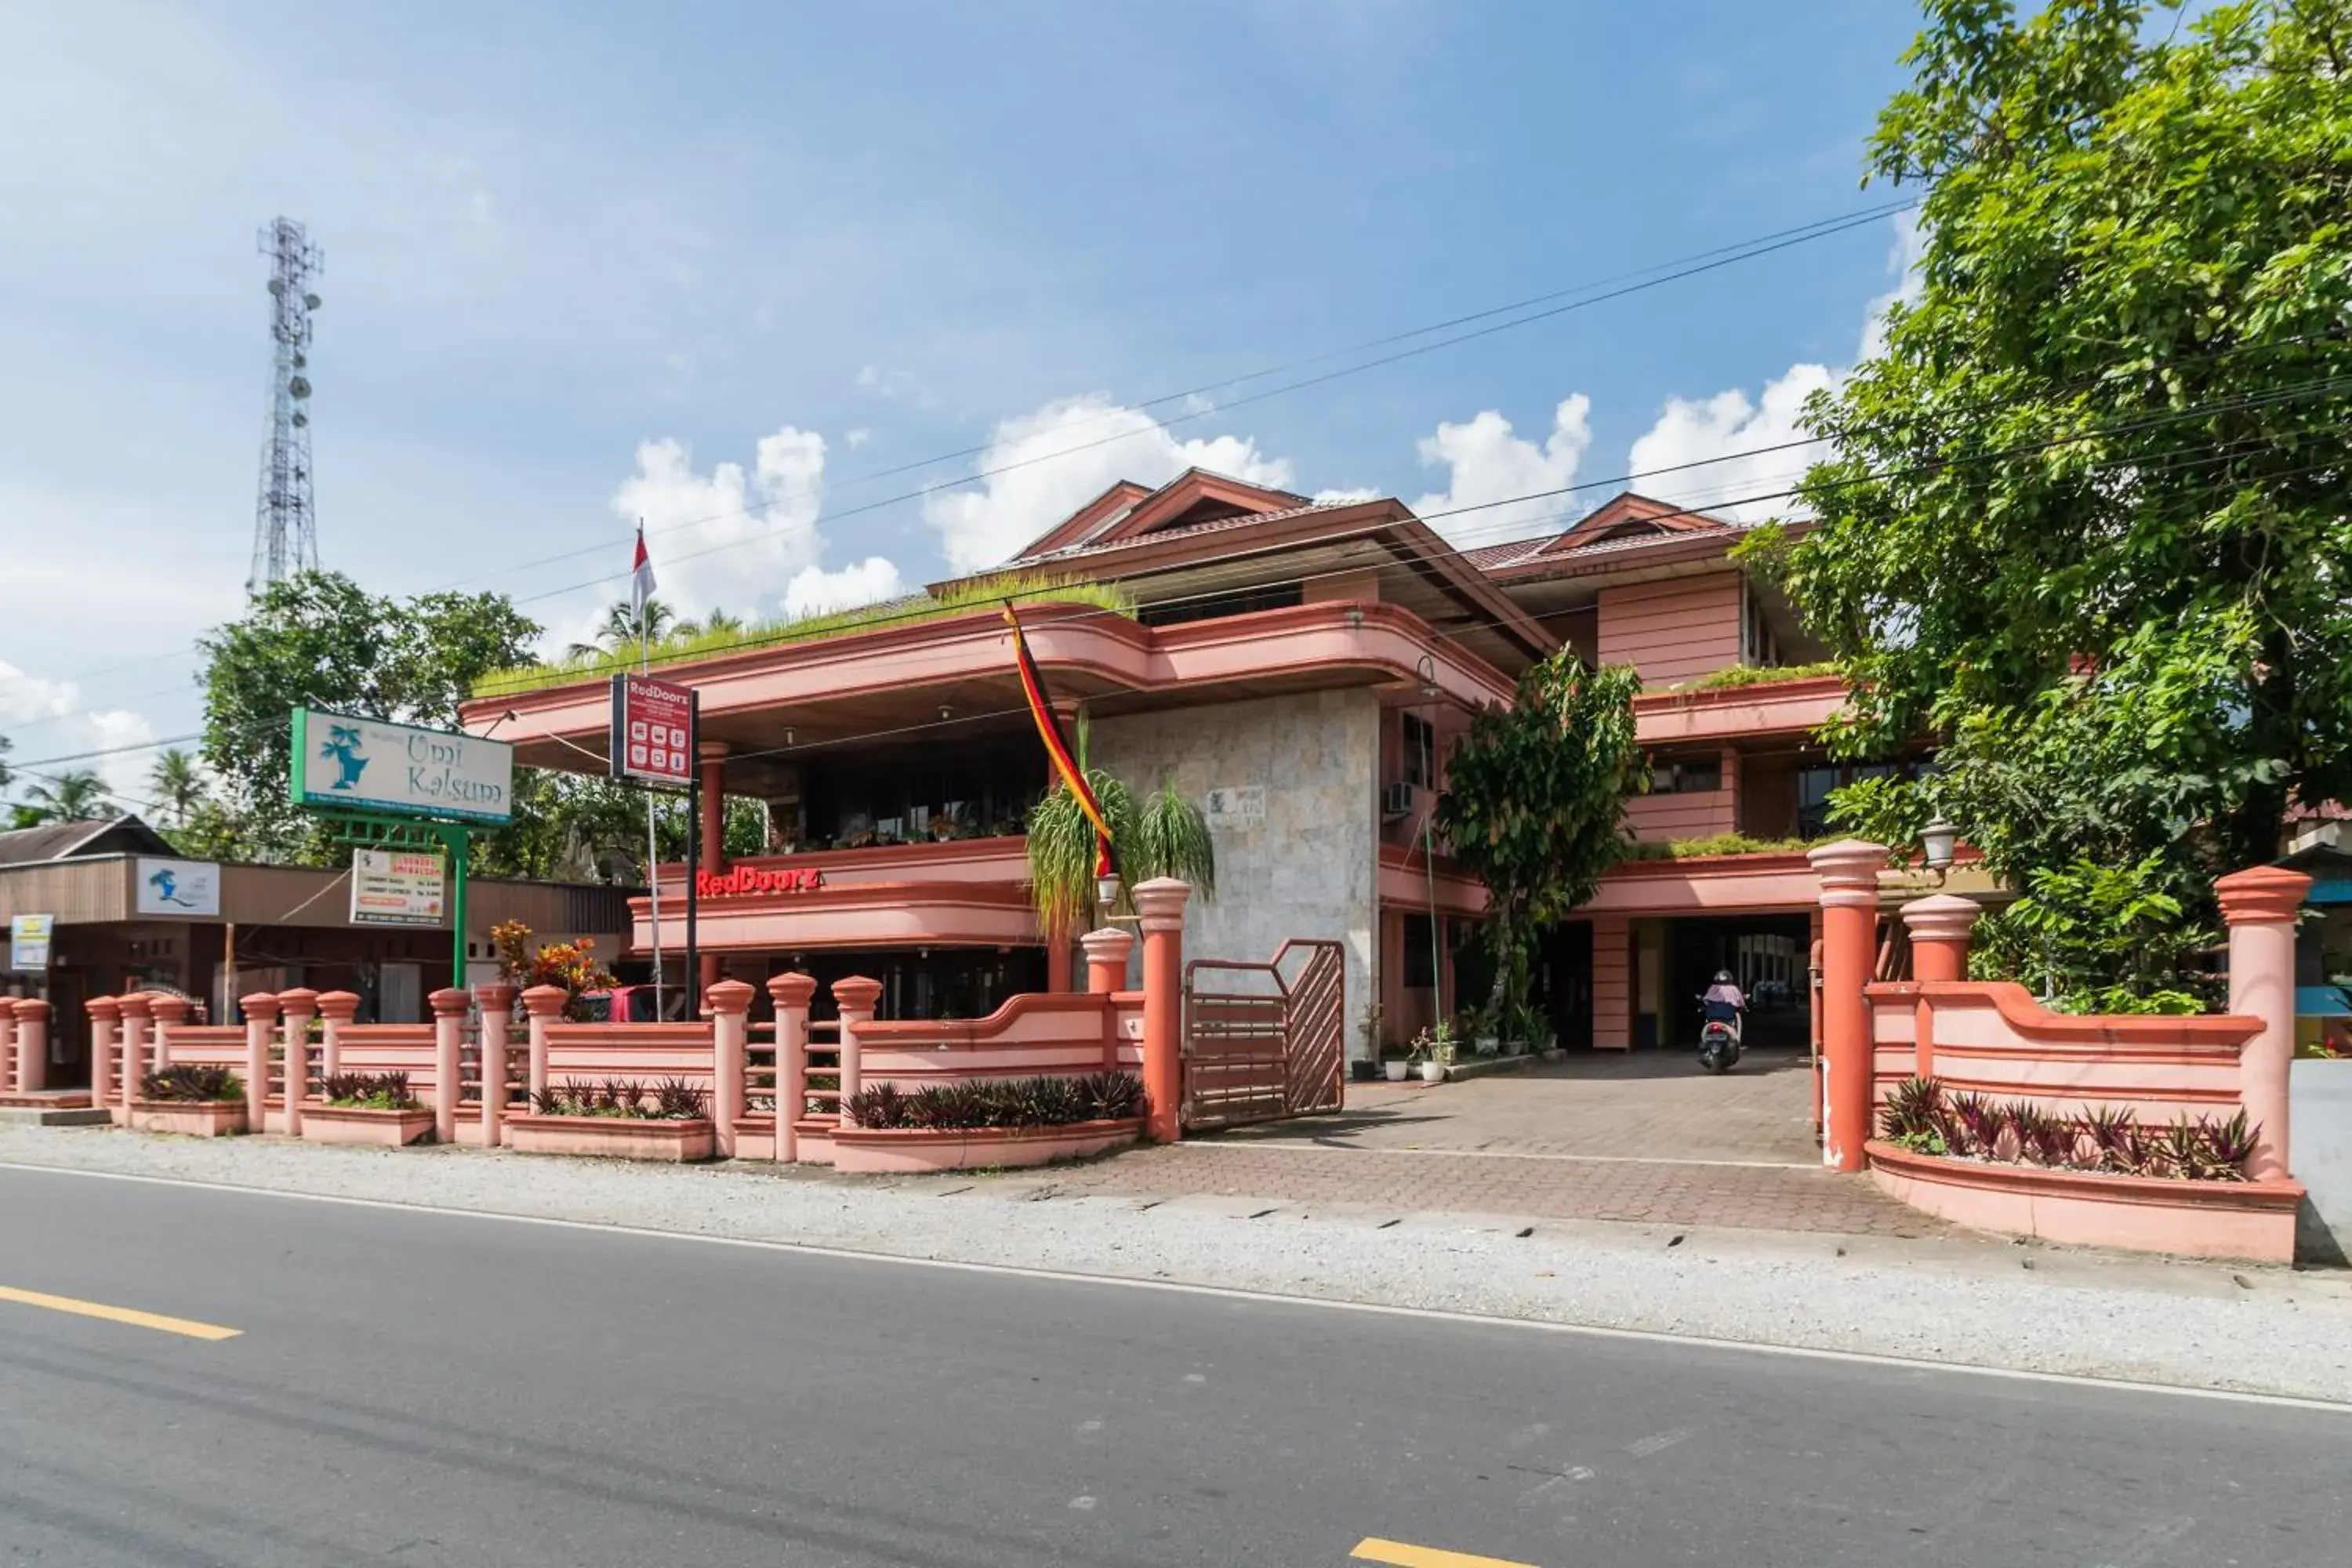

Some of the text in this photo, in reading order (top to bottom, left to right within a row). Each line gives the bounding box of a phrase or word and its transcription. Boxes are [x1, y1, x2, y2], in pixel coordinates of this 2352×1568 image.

[630, 681, 689, 705] RedDoorz
[407, 734, 463, 768] Umi
[407, 766, 503, 804] Kalsum
[696, 865, 820, 897] RedDoorz
